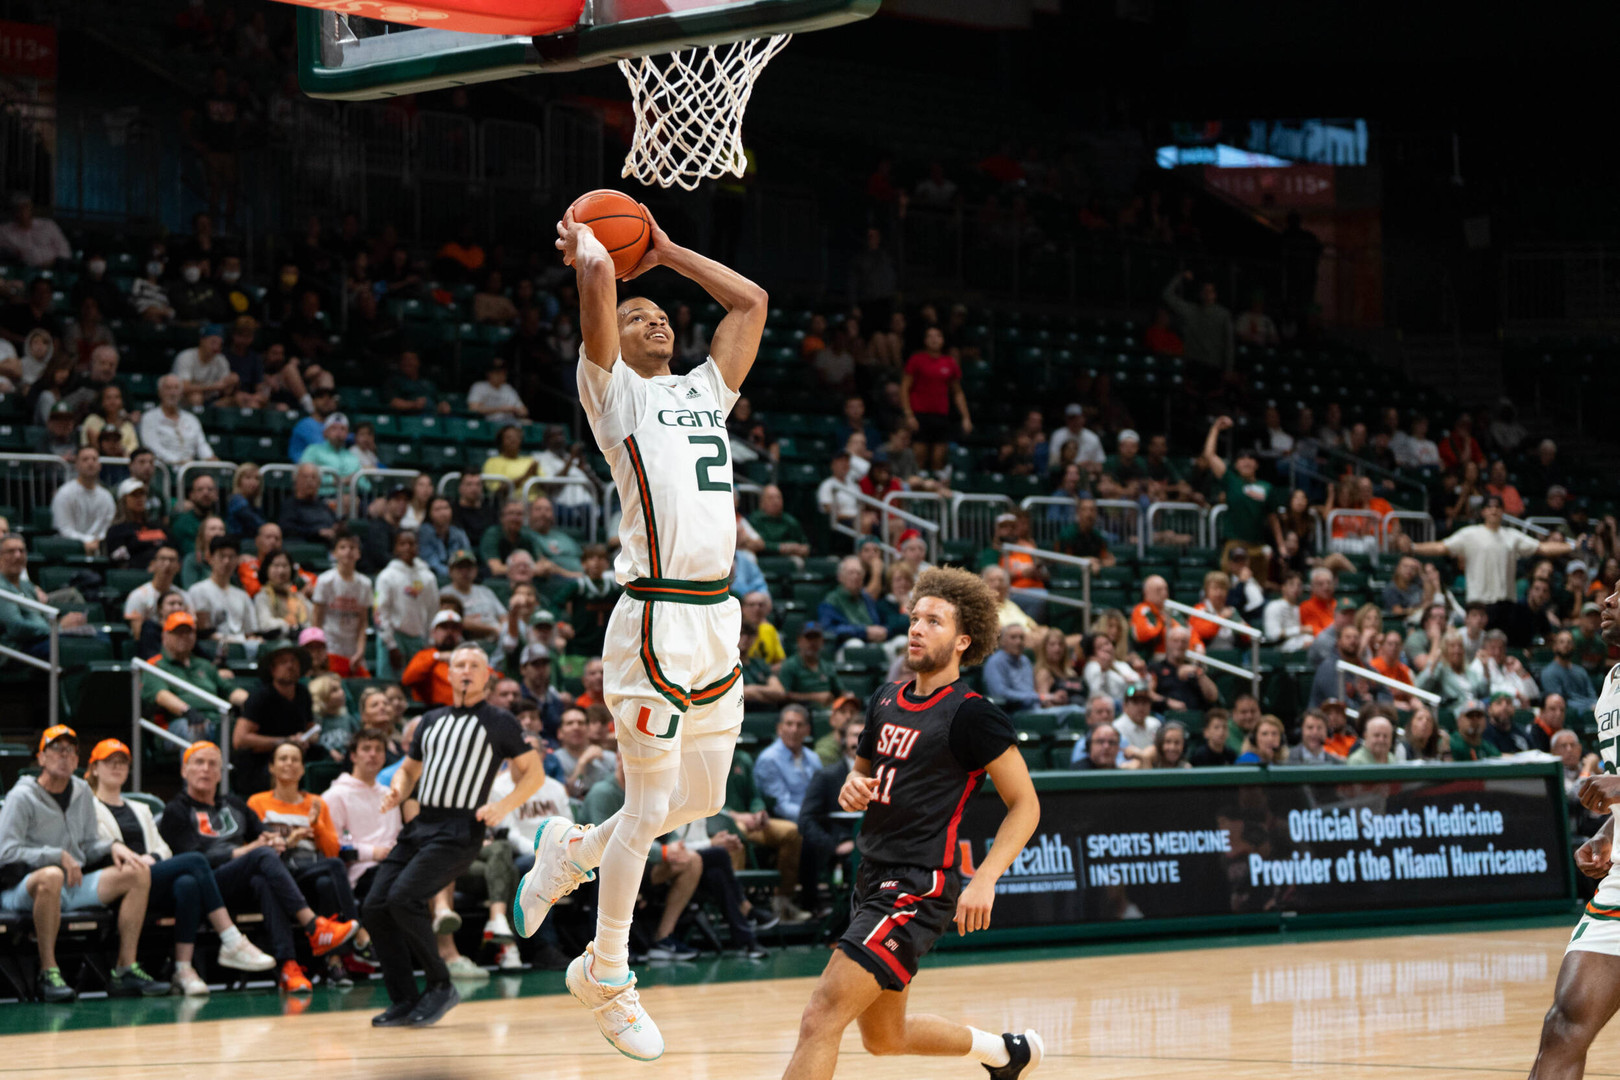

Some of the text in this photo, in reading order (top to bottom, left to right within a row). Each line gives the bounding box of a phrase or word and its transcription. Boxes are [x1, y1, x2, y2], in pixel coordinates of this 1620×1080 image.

[688, 435, 732, 492] 2
[877, 722, 921, 760] SFU
[871, 764, 897, 805] 11
[1087, 829, 1232, 859] SPORTS MEDICINE
[1288, 802, 1504, 847] Official Sports Medicine
[1089, 860, 1181, 887] INSTITUTE
[1248, 842, 1548, 887] Provider of the Miami Hurricanes
[884, 938, 899, 952] SFU
